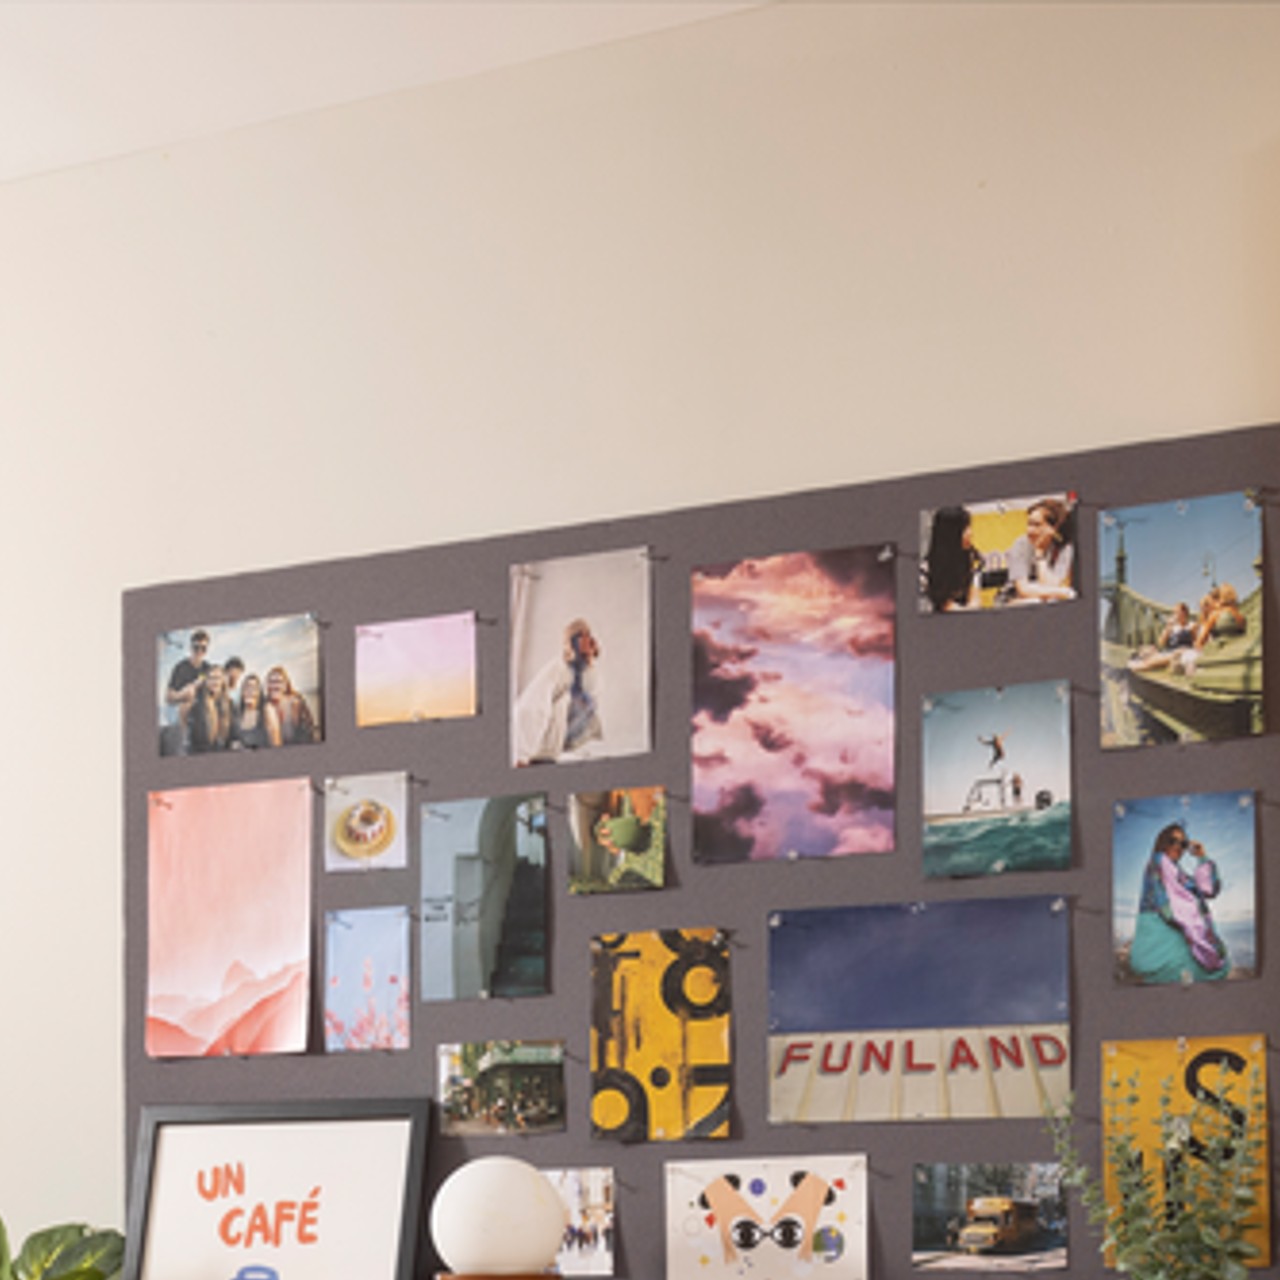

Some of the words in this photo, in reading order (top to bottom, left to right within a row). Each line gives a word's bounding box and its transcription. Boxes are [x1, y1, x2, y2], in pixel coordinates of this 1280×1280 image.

[779, 1033, 1068, 1076] FUNLAND
[197, 1161, 245, 1201] UN
[219, 1186, 321, 1248] CAFÉ
